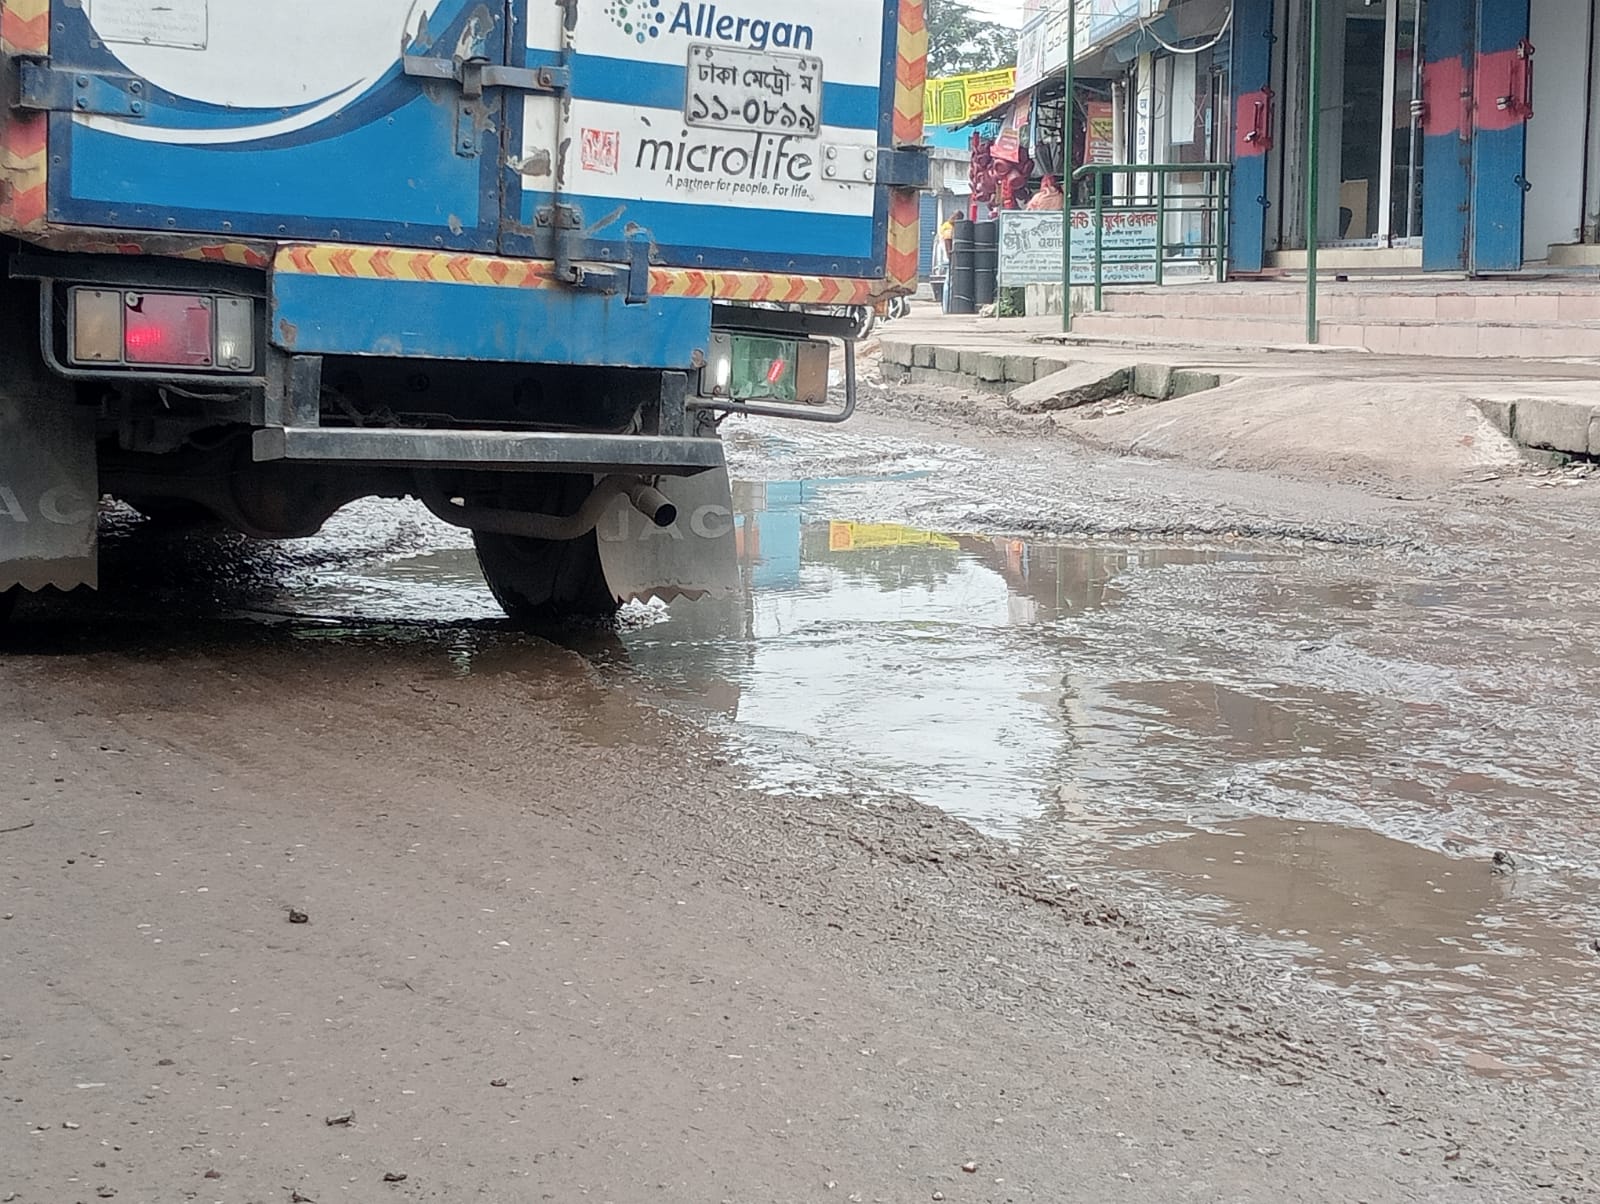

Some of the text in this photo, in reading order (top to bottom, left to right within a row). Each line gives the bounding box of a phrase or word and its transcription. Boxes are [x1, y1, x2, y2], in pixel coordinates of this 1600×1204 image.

[669, 2, 813, 50] Allergan
[697, 63, 738, 85] ঢাকা
[691, 93, 815, 130] ১১-০৮৯৯
[635, 129, 812, 181] microlife
[665, 174, 810, 198] A partner for people. For life.
